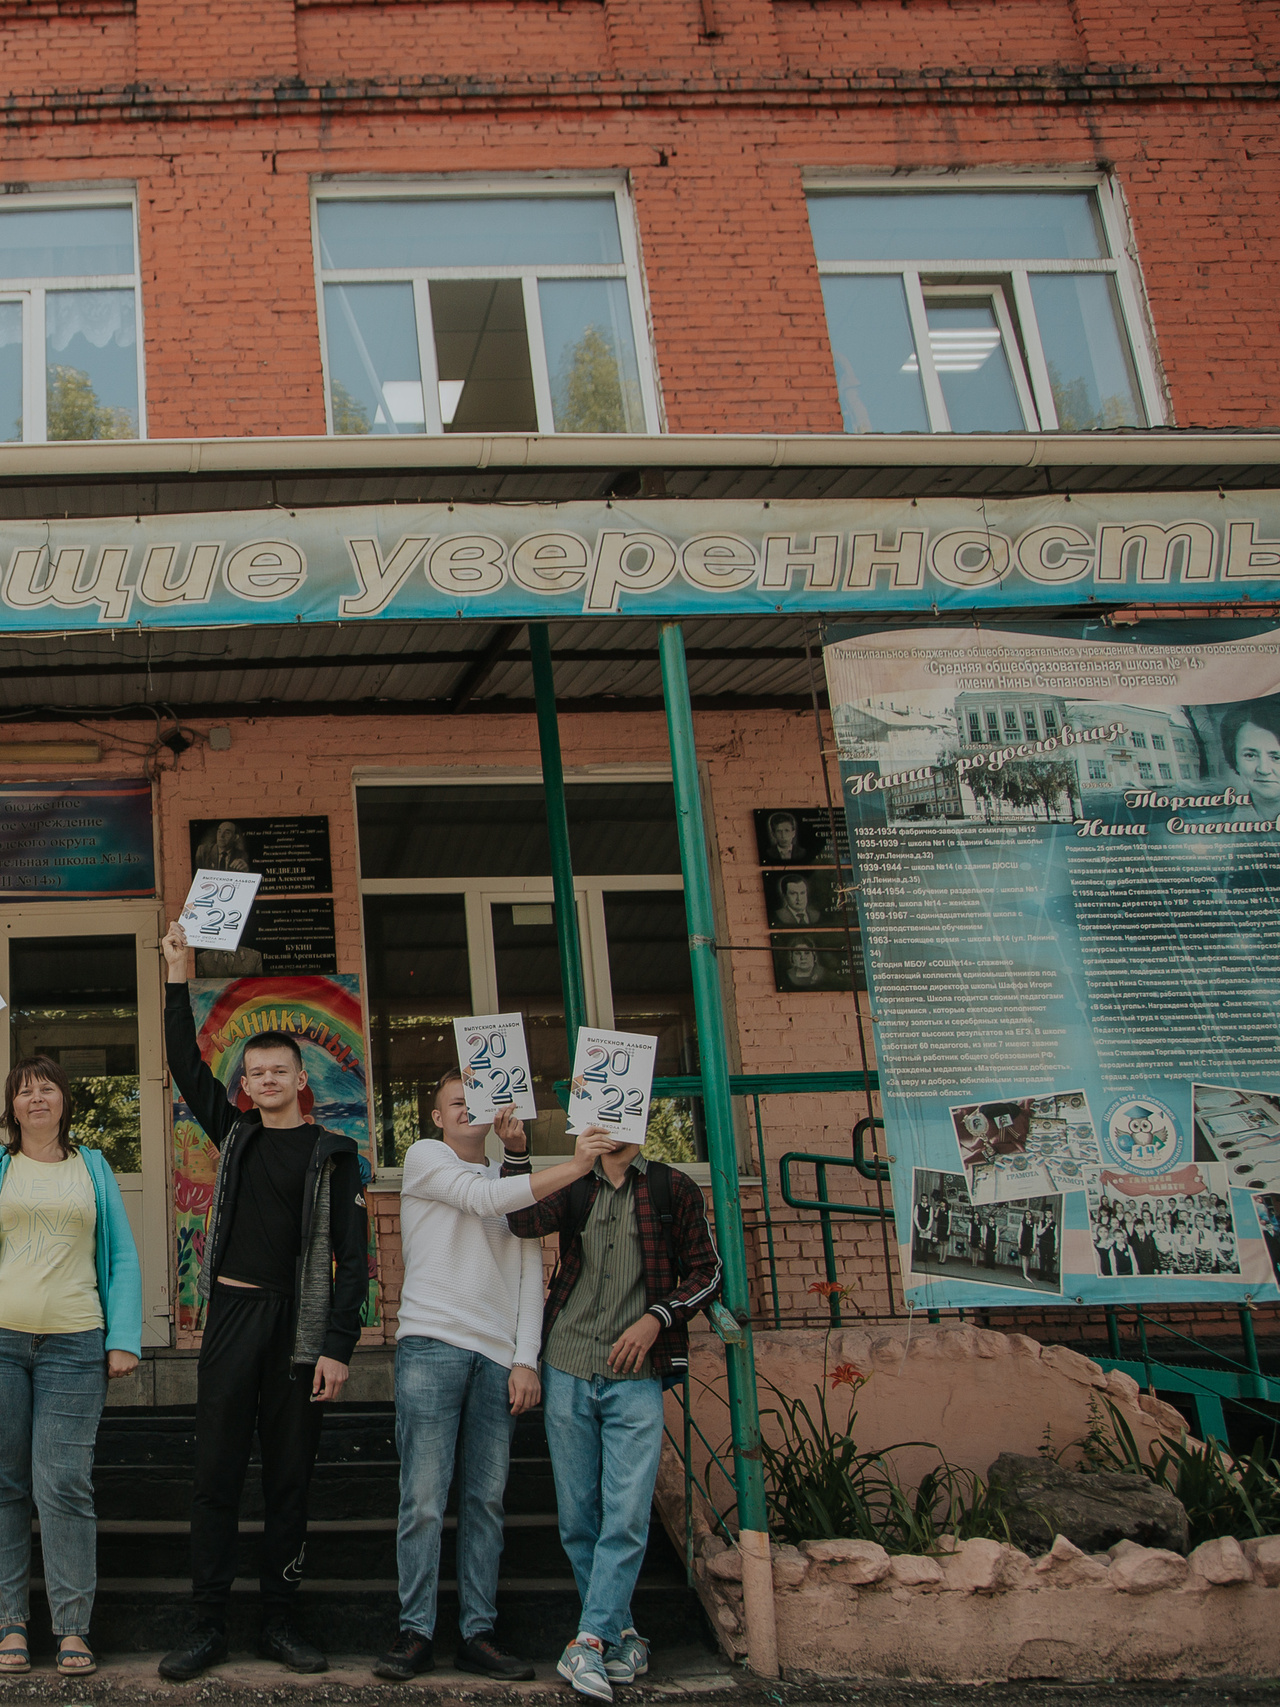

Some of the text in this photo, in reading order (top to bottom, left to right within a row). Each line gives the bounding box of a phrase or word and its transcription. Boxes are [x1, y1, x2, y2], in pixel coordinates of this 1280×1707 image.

[338, 518, 1280, 618] уверенность
[832, 648, 909, 661] Муниципальное
[911, 648, 965, 659] бюджетное
[967, 645, 1075, 659] общеобразовательное
[1077, 645, 1135, 658] учреждение
[1136, 644, 1201, 656] Киселевского
[1203, 644, 1256, 656] городского
[924, 656, 1205, 676] «Средняя общеобразовательная школа № 14»
[956, 673, 1177, 690] имени Нины Степановны Торгаевой
[845, 721, 1128, 795] Наша родословная
[4, 799, 81, 814] бюджетное
[1123, 786, 1253, 812] Торгаева
[20, 817, 103, 833] учреждение
[854, 827, 897, 836] 1932-1934
[1073, 818, 1150, 837] Нина
[49, 836, 97, 850] округа
[856, 839, 898, 848] 1935-1939
[53, 855, 96, 867] школа
[858, 863, 902, 872] 1939-1944
[193, 881, 236, 907] 20
[862, 887, 905, 896] 1944-1954
[199, 908, 242, 935] 22
[865, 911, 908, 920] 1959-1967
[210, 1009, 360, 1072] КАНИКУЛЫ!
[466, 1031, 506, 1070] 20
[583, 1045, 630, 1083] 20
[487, 1065, 528, 1105] 22
[597, 1084, 644, 1123] 22
